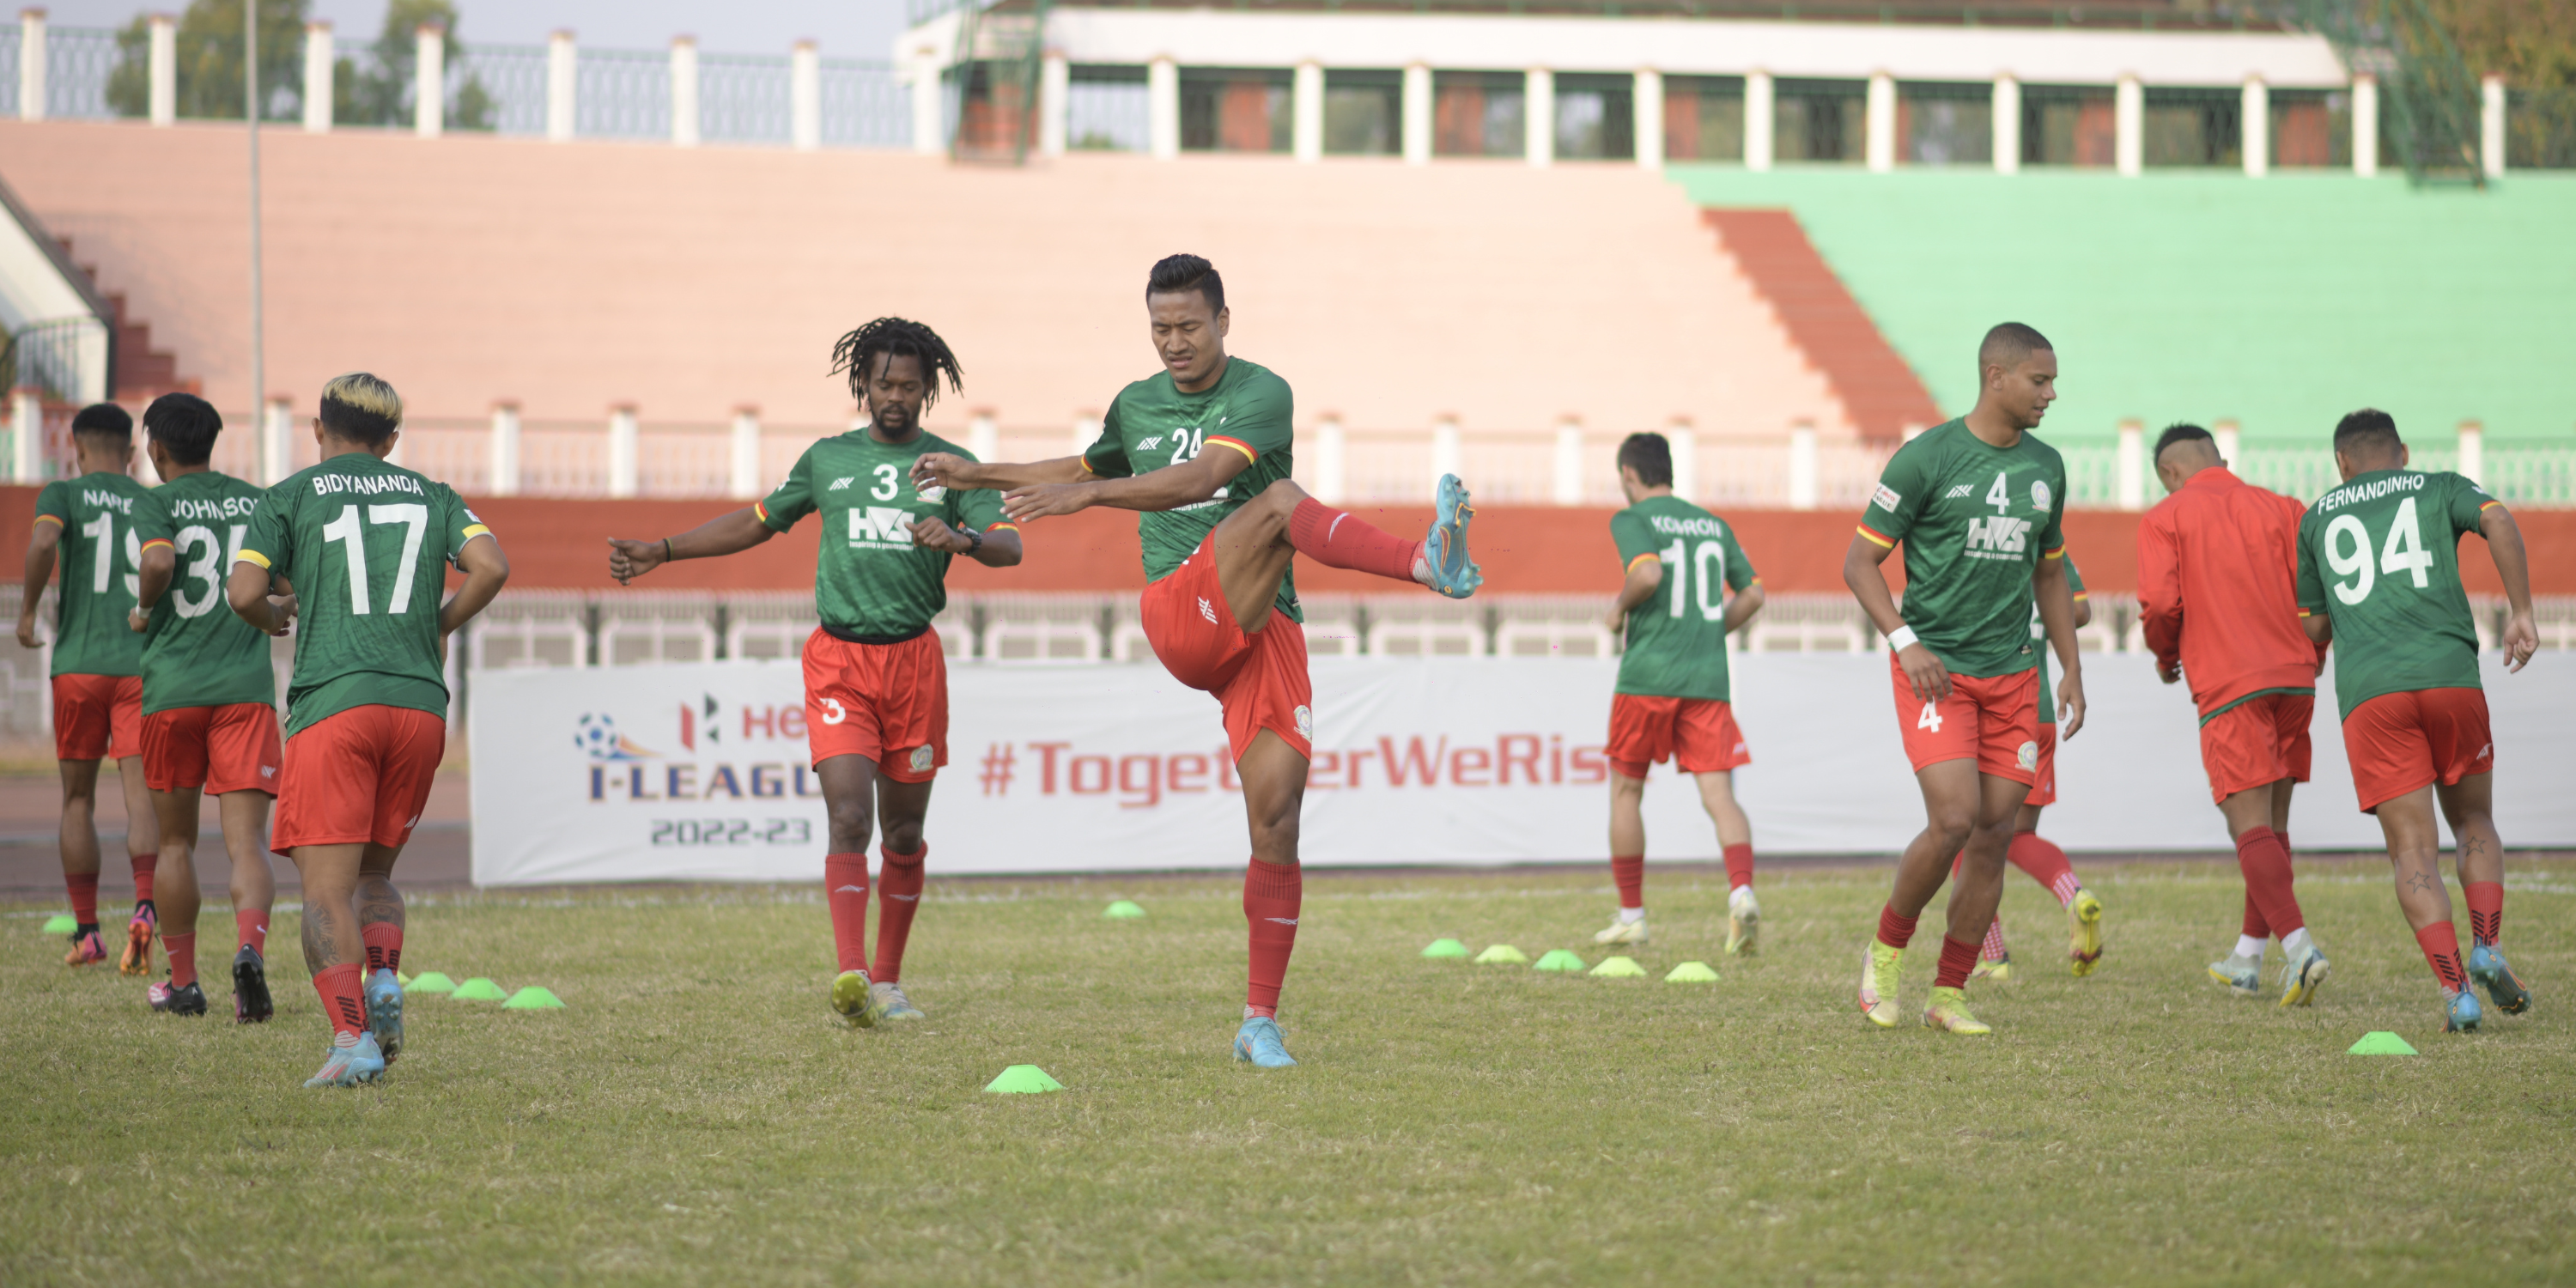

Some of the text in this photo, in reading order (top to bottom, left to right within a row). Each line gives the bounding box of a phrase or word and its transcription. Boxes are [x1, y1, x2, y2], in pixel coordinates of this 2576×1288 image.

[1170, 428, 1202, 465] 24
[313, 473, 424, 496] BIDYANANDA
[871, 464, 898, 501] 3
[1985, 471, 2009, 514] 4
[2318, 474, 2424, 515] FERNANDINHO
[83, 489, 133, 515] NARE
[172, 496, 258, 520] JOHNSO
[848, 506, 915, 542] HVS
[1965, 515, 2032, 552] HVS
[323, 503, 428, 615] 17
[2324, 496, 2433, 606] 94
[1659, 538, 1724, 620] 10
[819, 697, 846, 725] 3
[1917, 695, 1943, 732] 4
[588, 762, 824, 802] I-LEAGU
[651, 818, 811, 845] 2022-23
